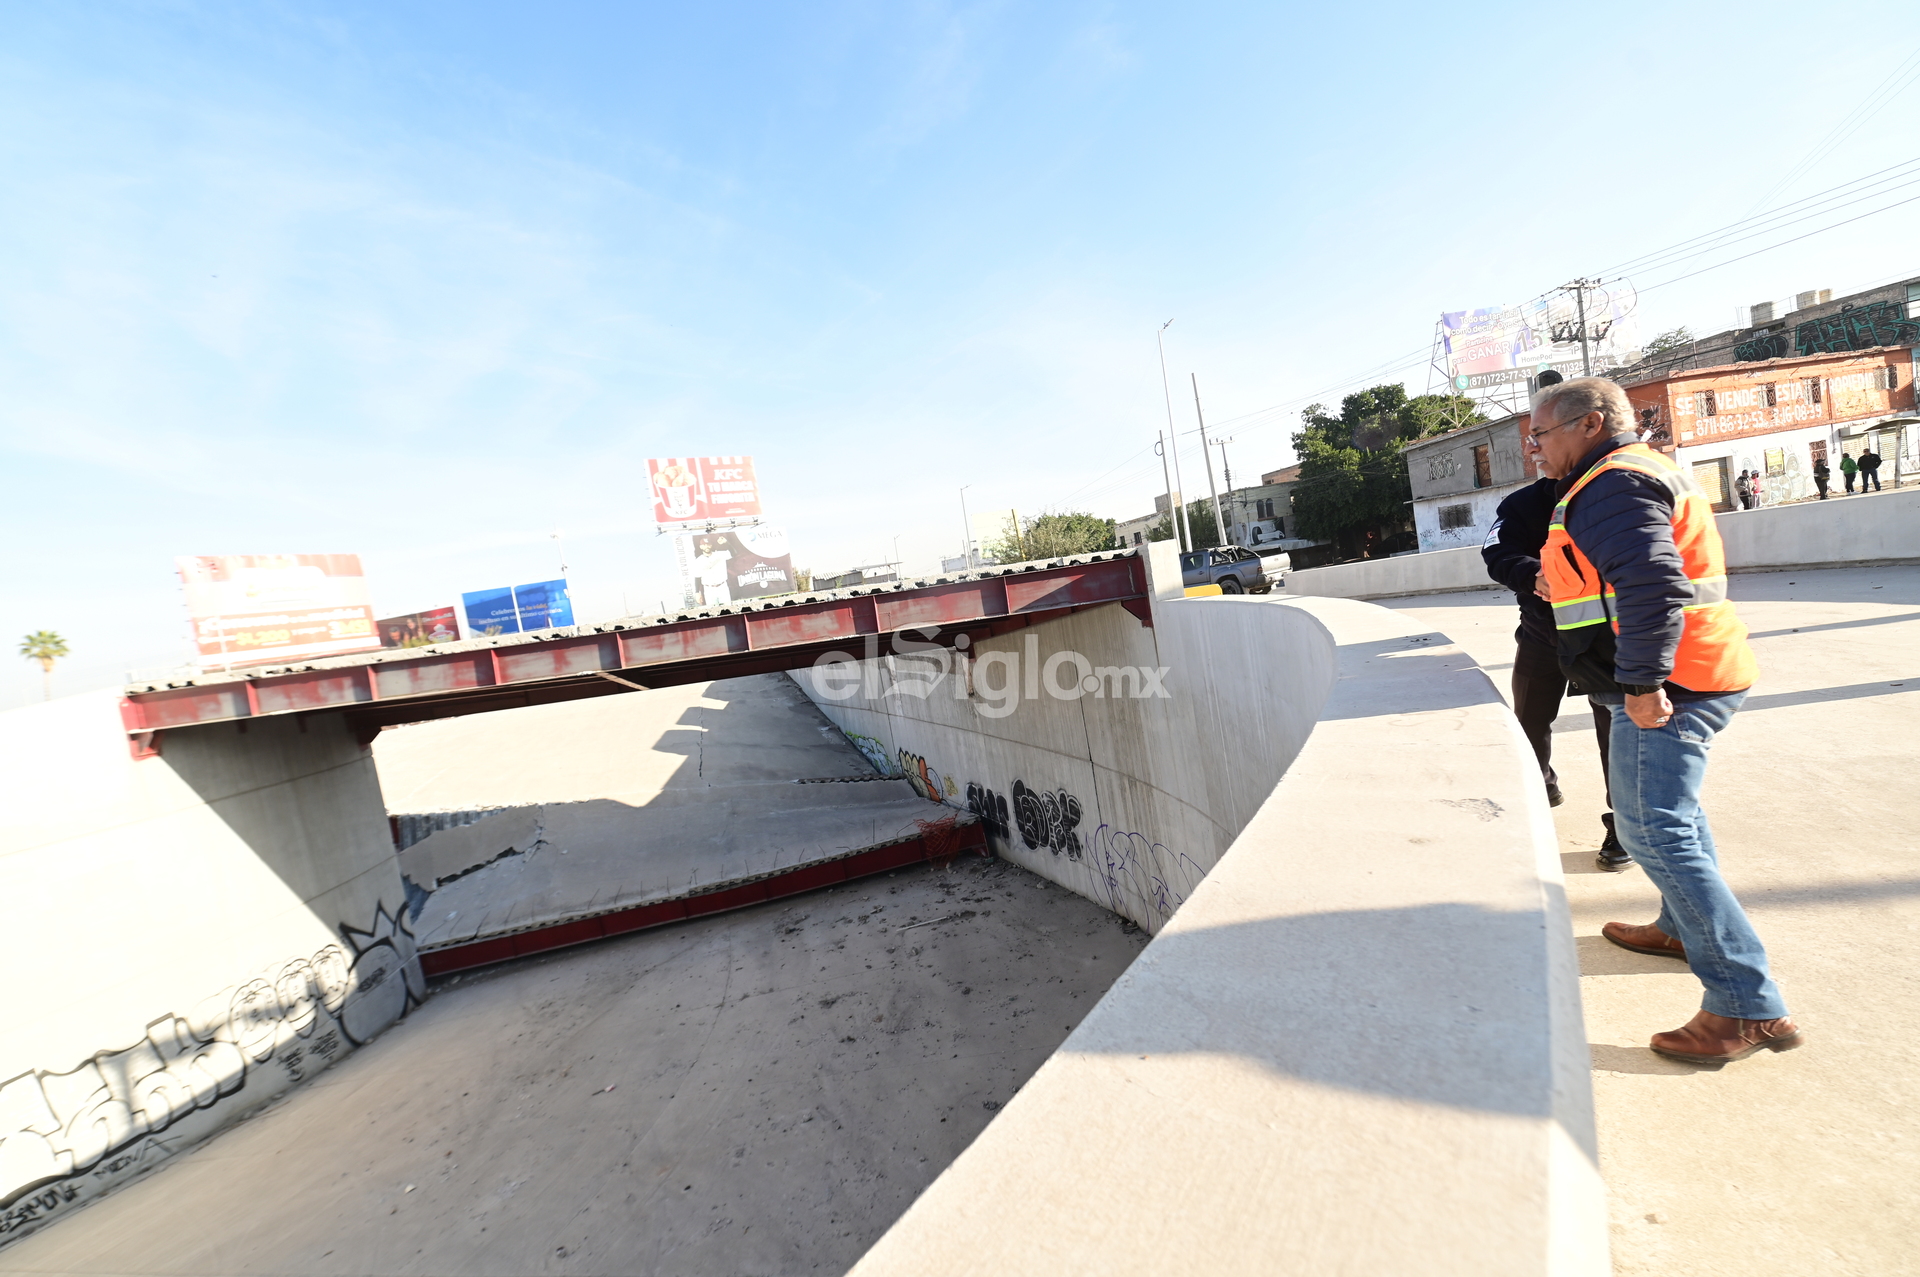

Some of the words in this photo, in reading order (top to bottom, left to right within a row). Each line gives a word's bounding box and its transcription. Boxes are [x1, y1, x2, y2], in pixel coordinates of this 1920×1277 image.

[1459, 315, 1478, 324] Todo
[1489, 312, 1501, 320] tan
[1451, 326, 1472, 335] como
[1473, 323, 1492, 333] decir
[1452, 357, 1467, 366] para
[1468, 341, 1511, 361] GANAR
[1521, 353, 1553, 364] HomePod
[1470, 369, 1532, 387] (871)723-77-33
[1676, 397, 1694, 416] SE
[1715, 388, 1757, 410] VENDE
[1776, 382, 1804, 402] ESTA
[714, 468, 743, 480] KFC
[707, 482, 721, 492] TU
